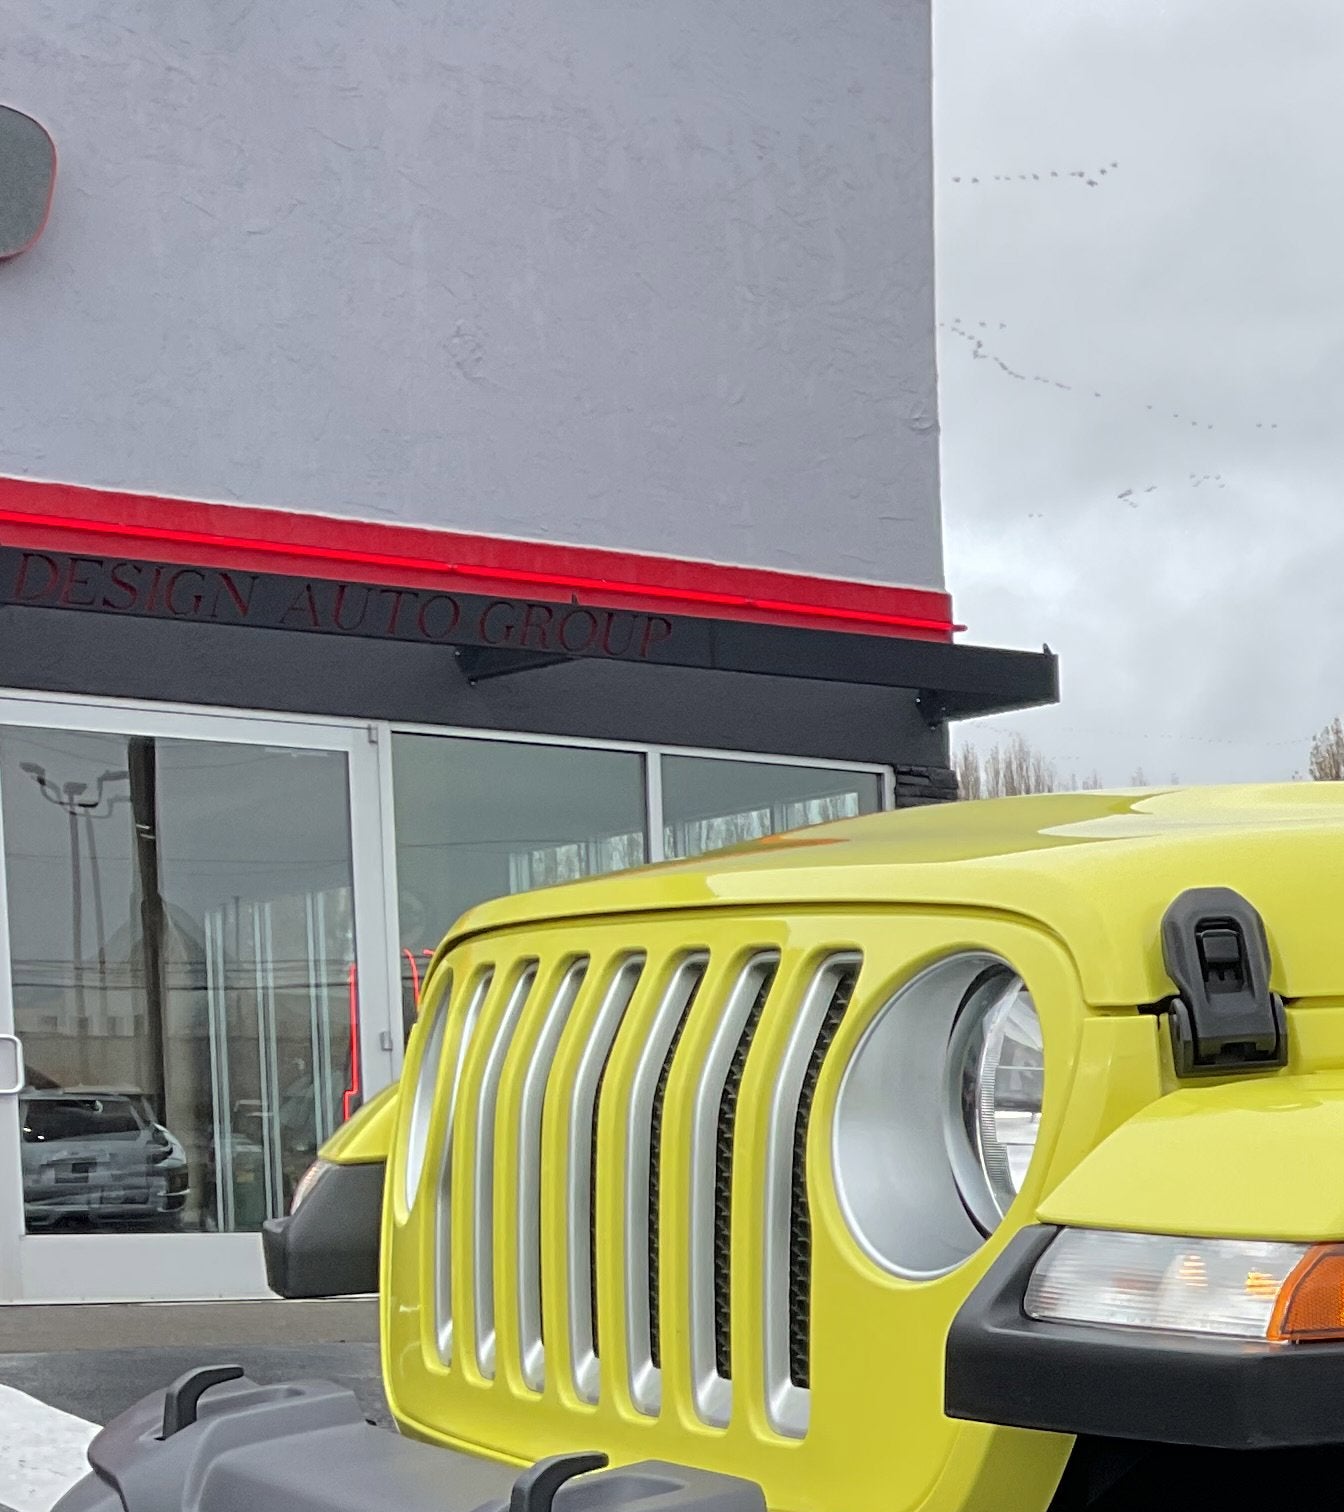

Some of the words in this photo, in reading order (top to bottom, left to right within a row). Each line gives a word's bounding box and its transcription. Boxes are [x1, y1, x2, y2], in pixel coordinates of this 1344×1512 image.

[14, 552, 259, 618] DESIGN
[278, 582, 461, 640] AUTO
[479, 600, 673, 658] GROUP
